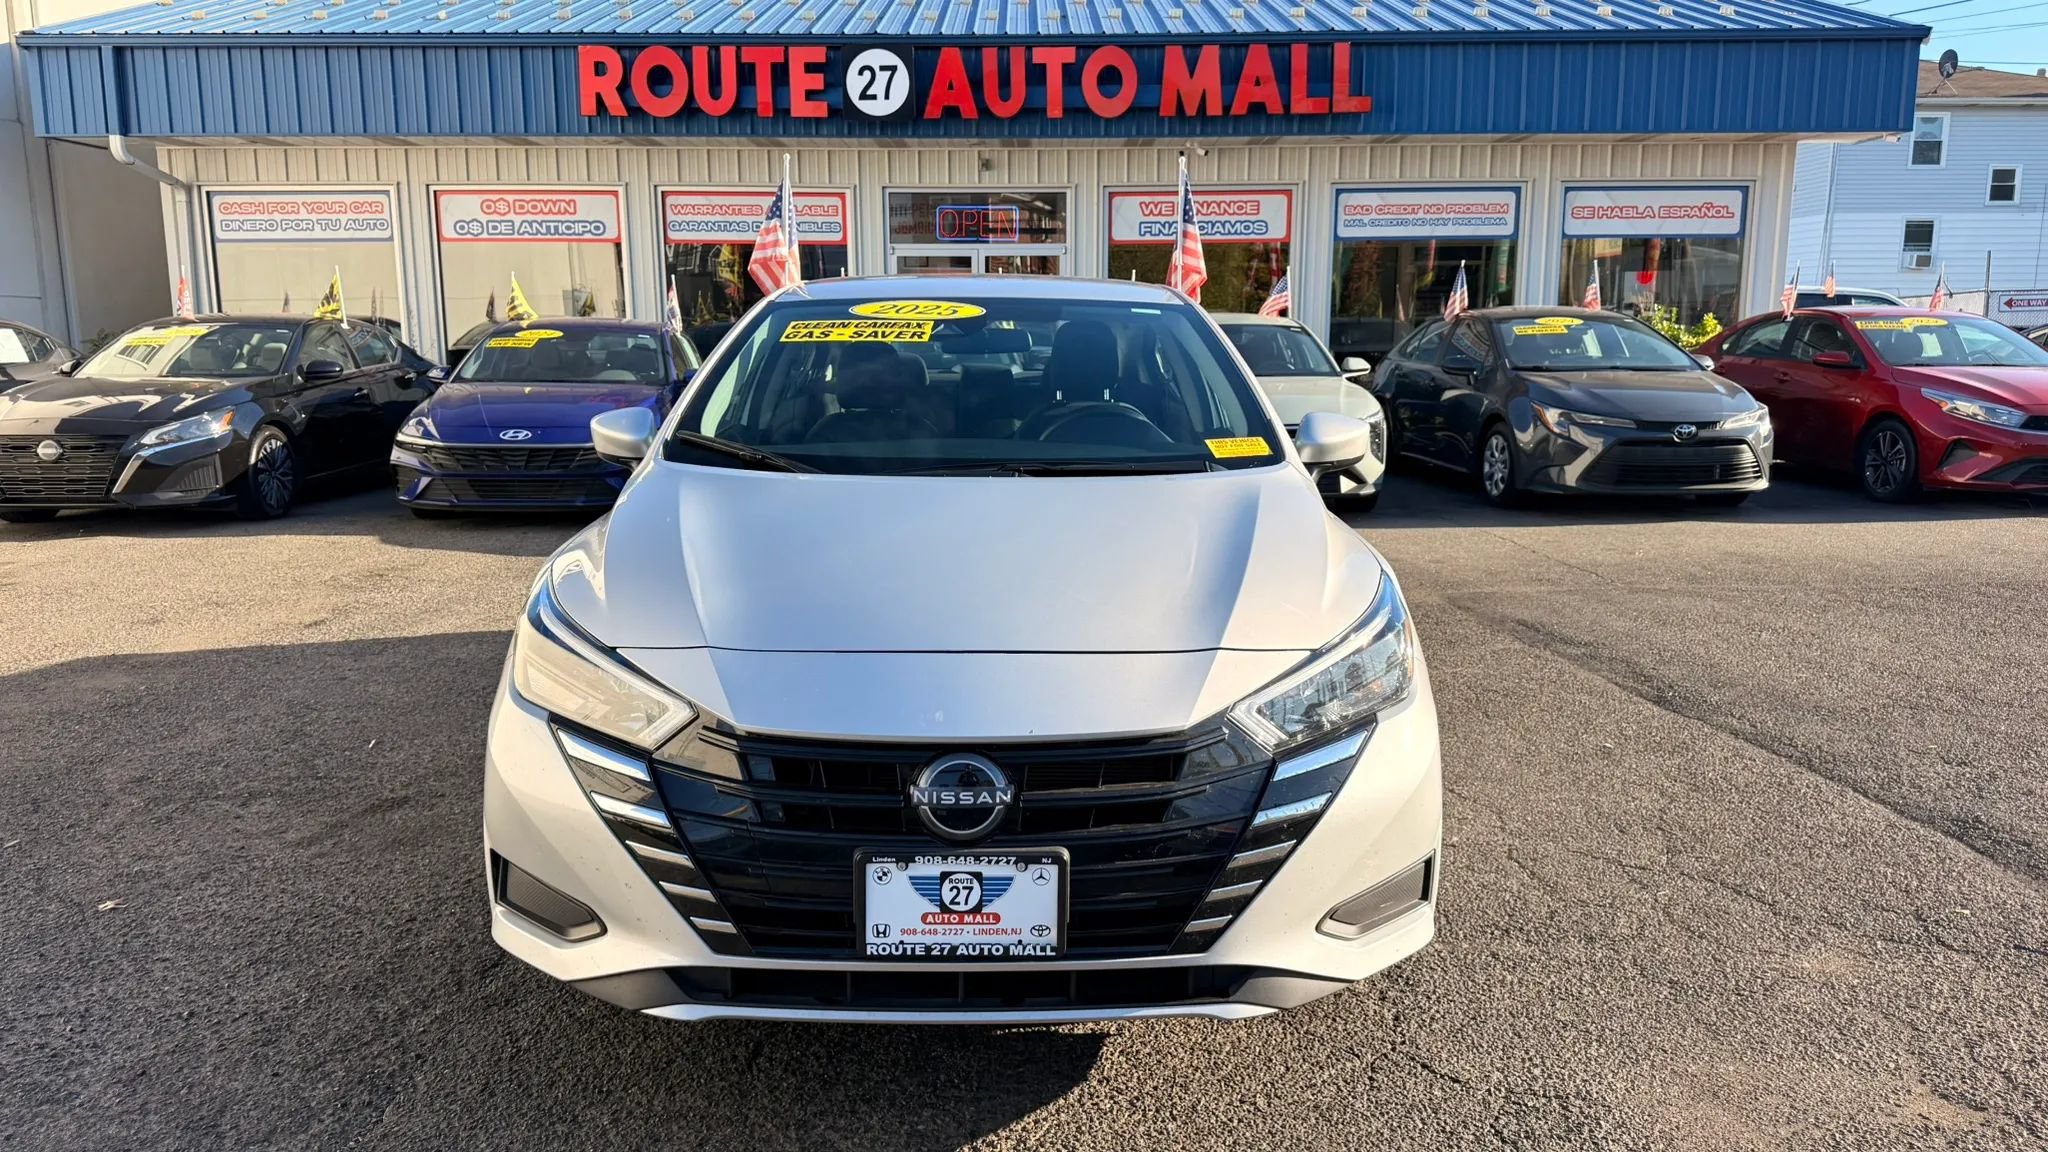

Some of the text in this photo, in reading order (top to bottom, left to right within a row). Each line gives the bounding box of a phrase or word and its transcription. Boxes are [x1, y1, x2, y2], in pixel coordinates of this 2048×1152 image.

[578, 42, 1372, 119] ROUTE 27 AUTO MALL
[219, 200, 384, 214] CASH FOR YOUR CAR
[513, 199, 577, 215] DOWN
[671, 204, 763, 216] WARRANTIES
[1140, 201, 1174, 216] WE
[1344, 203, 1509, 216] BAD CREDIT NO PROBLEM
[1572, 202, 1735, 219] SE HABLA ESPAÑOL
[221, 218, 389, 232] DINERO POR TU AUTO
[486, 220, 515, 236] DE
[517, 220, 606, 236] ANTICIPO
[668, 220, 752, 232] GARANTIAS
[940, 208, 1017, 238] OPEN
[1139, 220, 1268, 236] FINACIAMOS
[1344, 217, 1507, 228] MAL CREDITO NO HAY PROBLEMA
[870, 304, 963, 316] 2025
[791, 321, 927, 330] CLEAN CARFAX
[784, 330, 833, 339] GAS
[853, 330, 927, 339] SAVER
[913, 790, 1011, 805] NISSAN
[914, 856, 1017, 865] 908-648-2727
[949, 886, 974, 905] 27
[926, 914, 996, 924] AUTO MALL
[900, 927, 1022, 937] 908-648-2727 LINDEN,NJ
[866, 943, 1056, 956] ROUTE 27 AUTO MALL
